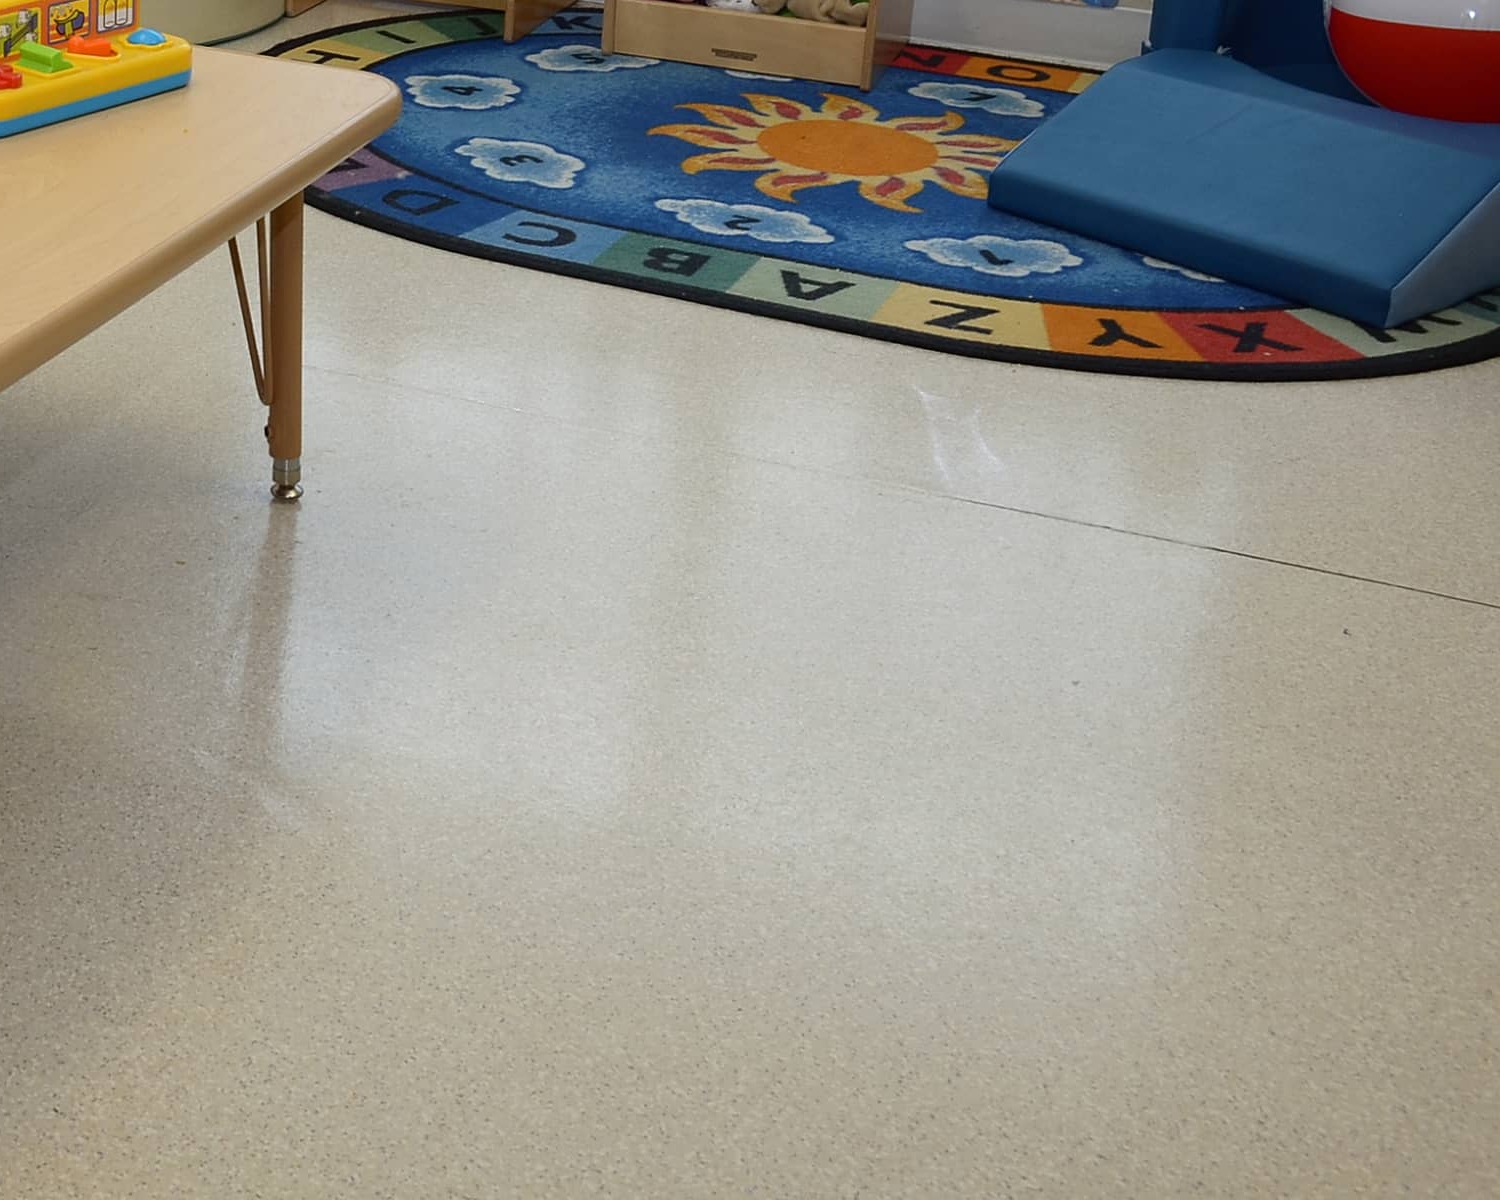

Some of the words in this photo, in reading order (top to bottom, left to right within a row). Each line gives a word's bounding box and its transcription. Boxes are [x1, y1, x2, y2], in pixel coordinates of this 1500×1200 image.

[573, 52, 605, 65] 5
[986, 64, 1051, 82] O
[440, 85, 484, 97] 4
[963, 91, 996, 102] 7
[500, 153, 545, 168] 3
[381, 189, 462, 216] D
[502, 221, 577, 248] C
[726, 214, 762, 231] 2
[642, 246, 712, 277] B
[778, 269, 857, 301] A
[924, 299, 1001, 334] Z
[1088, 318, 1163, 349] Y
[1195, 322, 1304, 353] X
